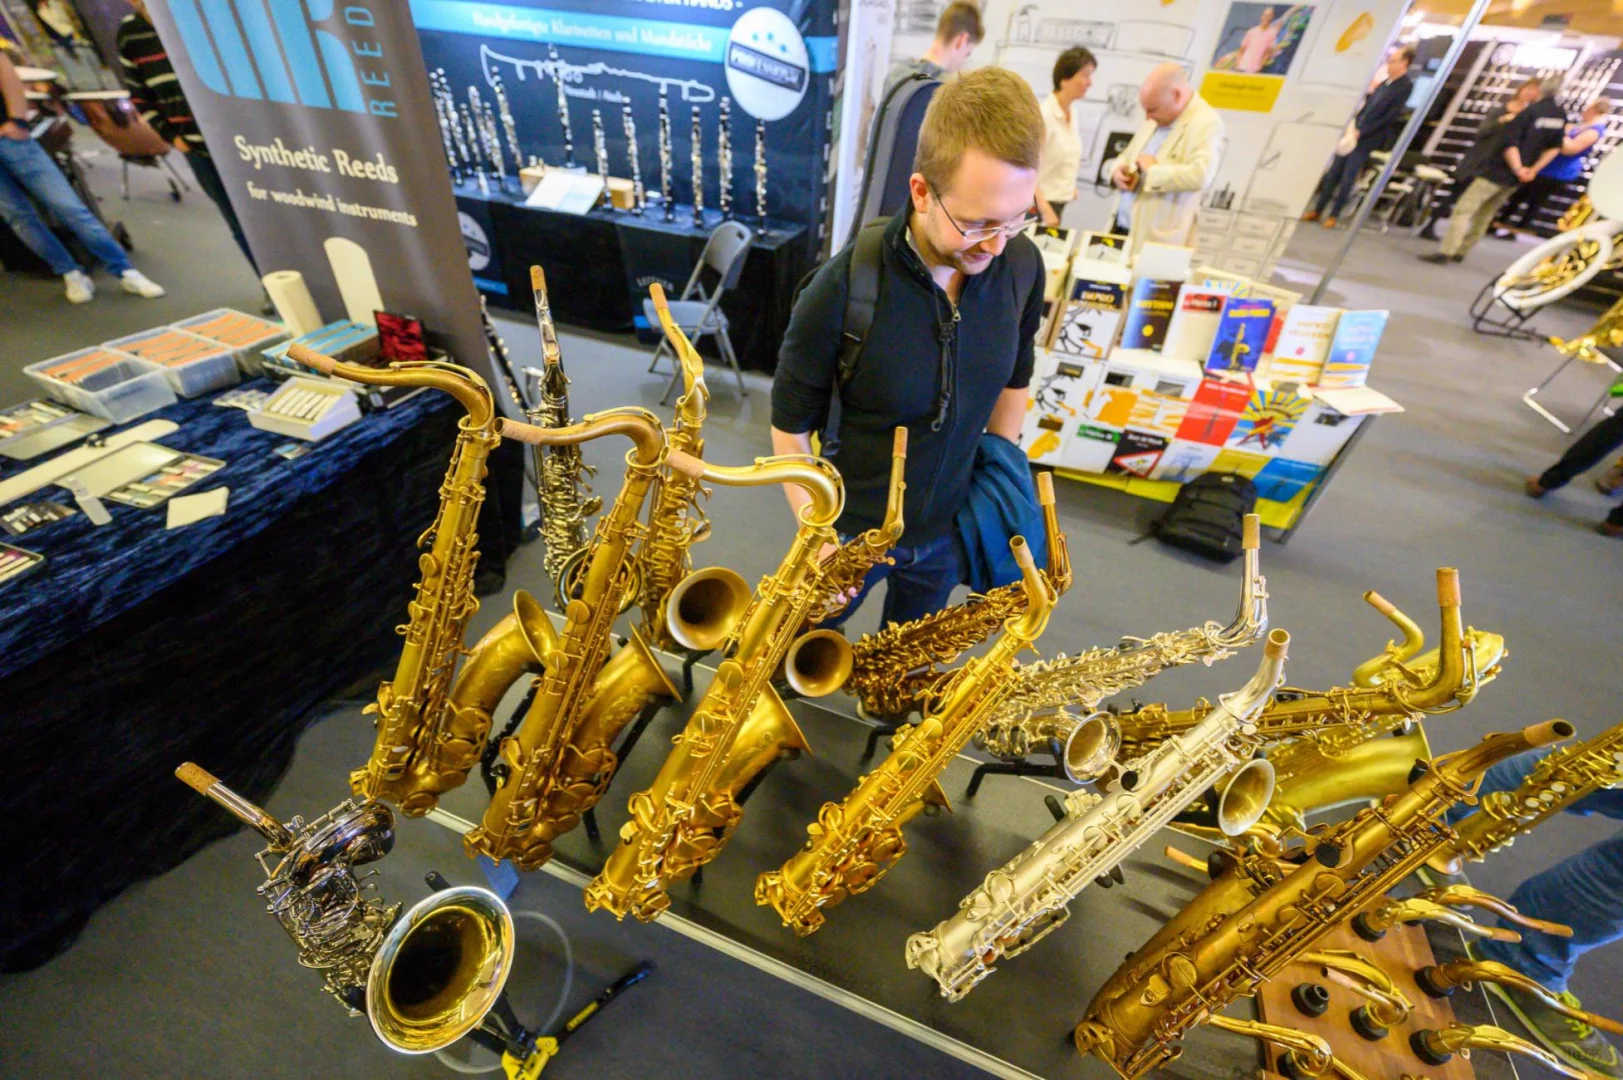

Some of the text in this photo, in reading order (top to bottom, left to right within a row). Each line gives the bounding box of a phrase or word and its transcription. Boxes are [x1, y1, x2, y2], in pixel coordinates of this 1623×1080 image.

[614, 25, 637, 44] und
[344, 6, 398, 118] REED
[234, 135, 399, 184] Synthetic Reeds
[247, 181, 418, 227] for woodwind instruments
